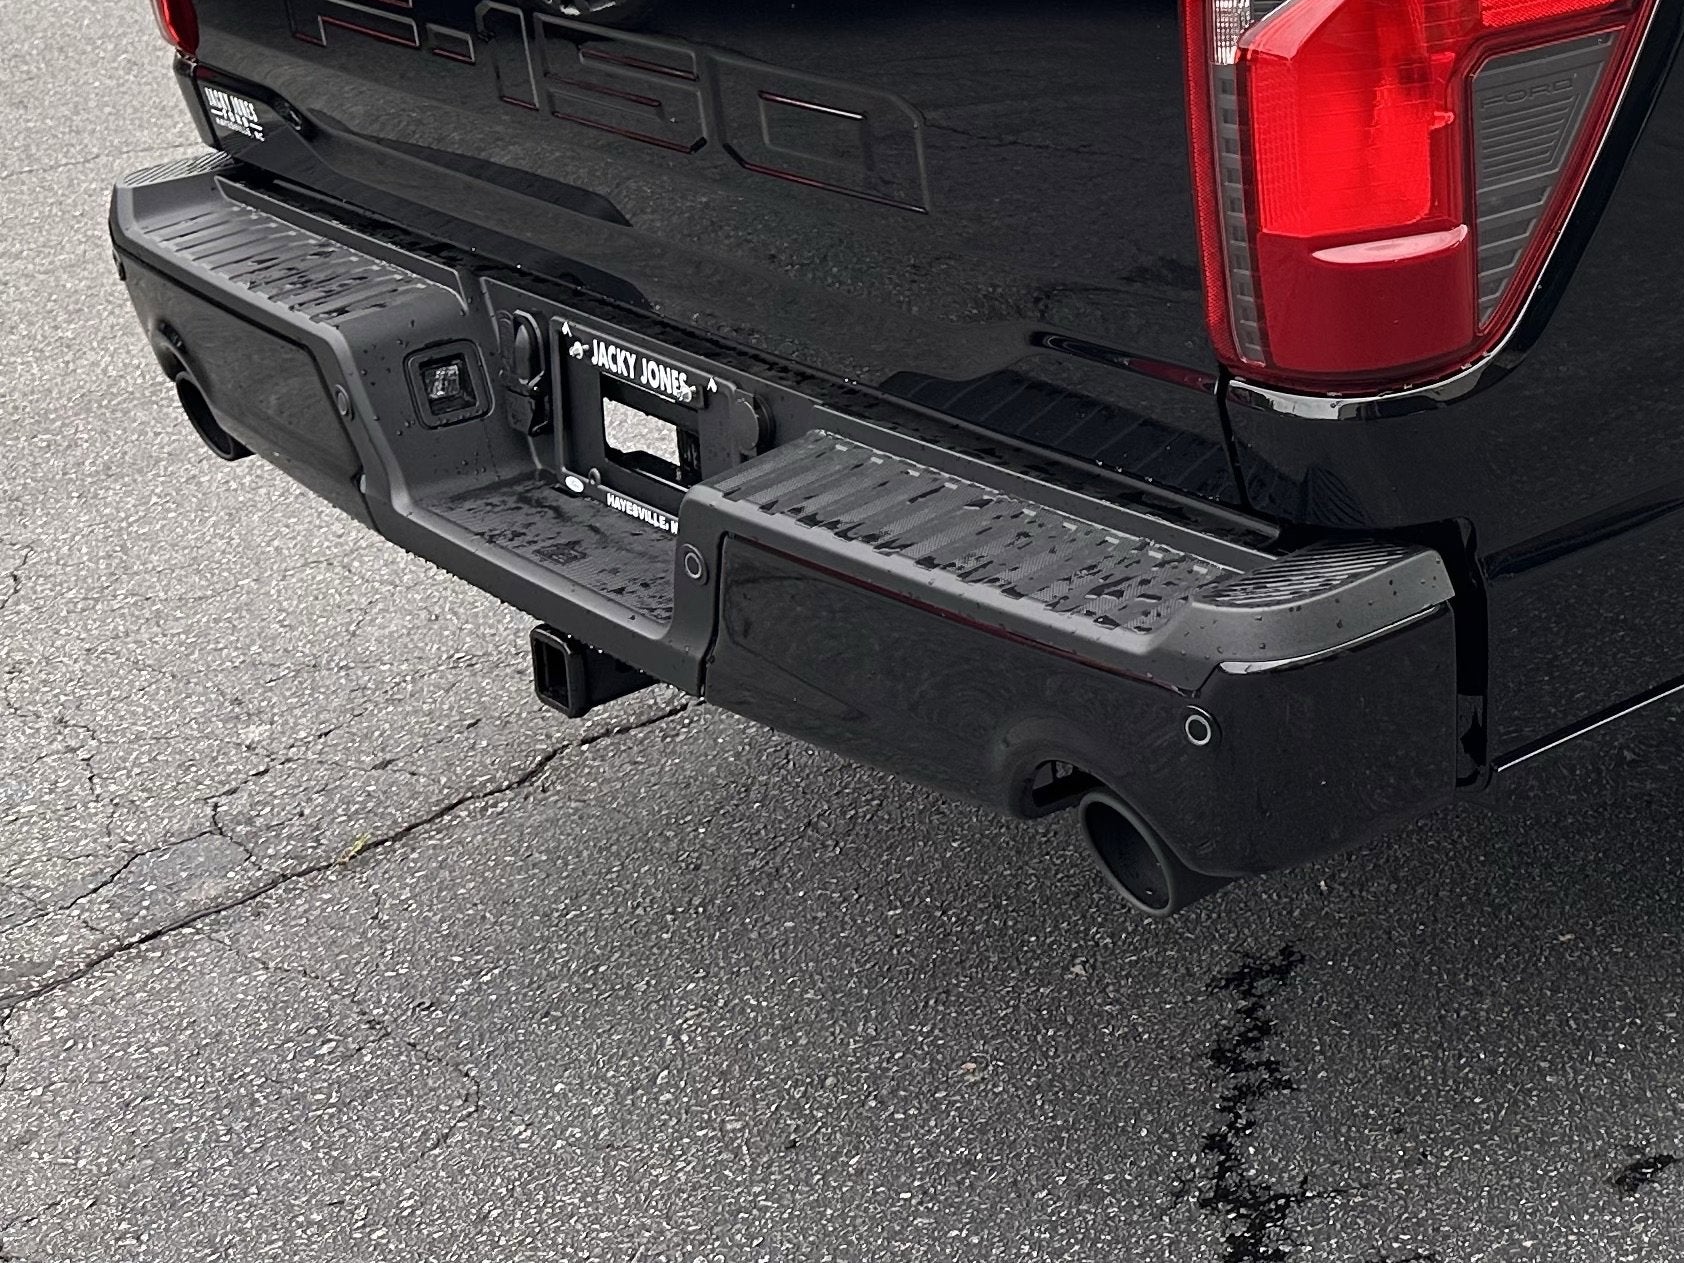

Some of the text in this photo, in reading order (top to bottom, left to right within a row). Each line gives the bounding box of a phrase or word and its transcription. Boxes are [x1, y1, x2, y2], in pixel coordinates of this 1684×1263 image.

[1481, 78, 1574, 110] FORD
[591, 338, 691, 400] JACKY JONES
[606, 492, 679, 535] HAYESVILLE, N
